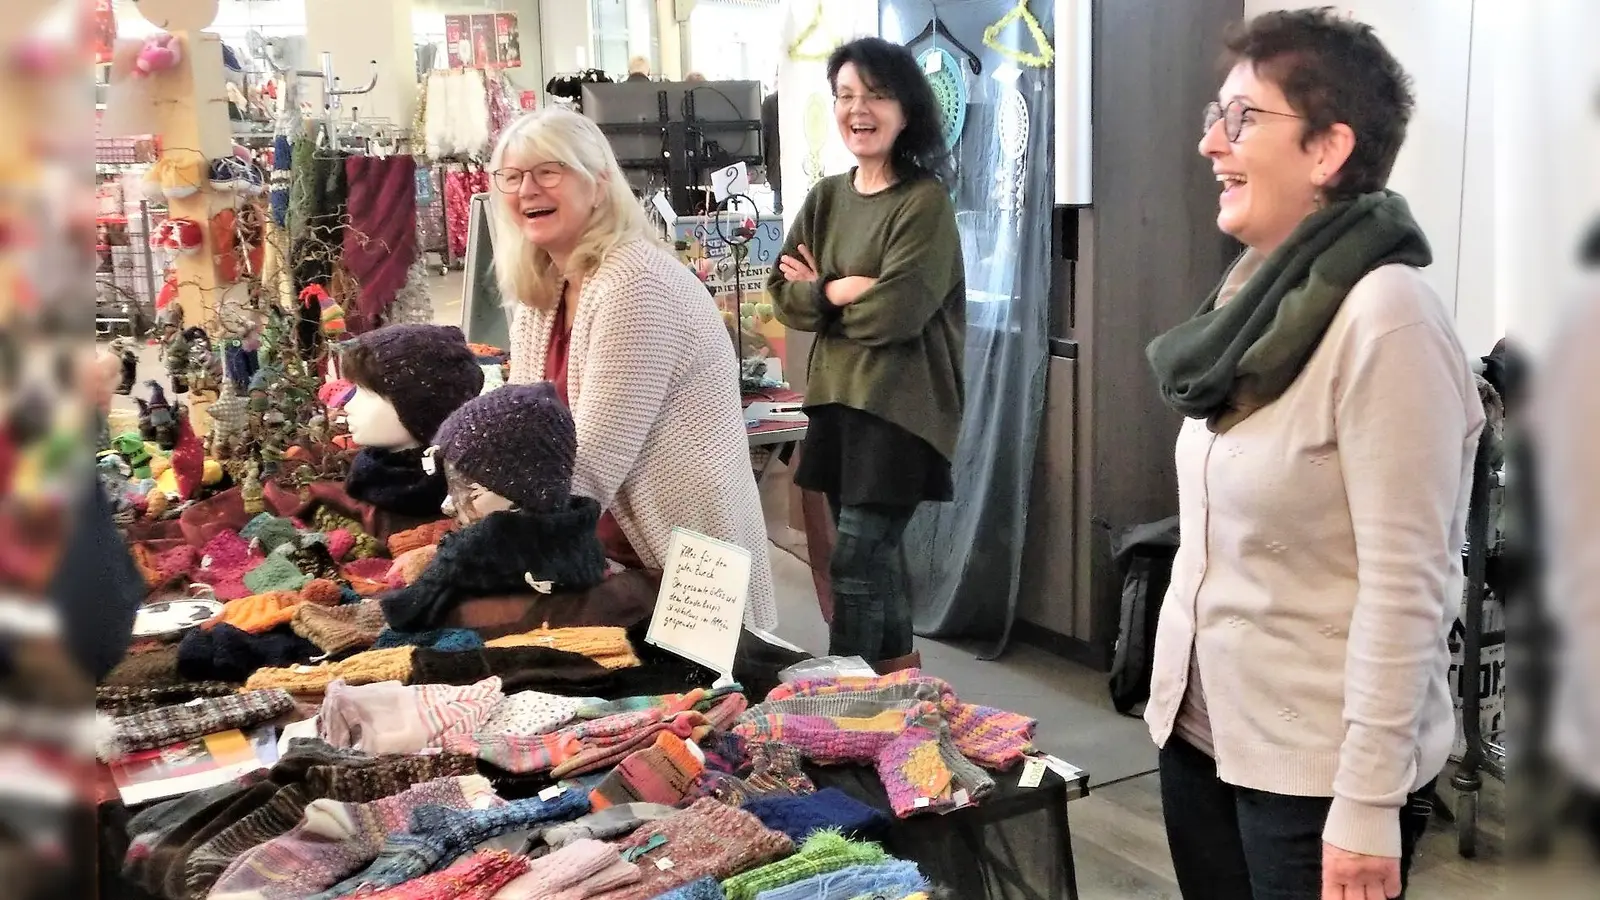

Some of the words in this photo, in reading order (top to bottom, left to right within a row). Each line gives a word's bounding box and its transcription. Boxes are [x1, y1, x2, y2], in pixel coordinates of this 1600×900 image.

[680, 543, 697, 560] Alles
[699, 550, 712, 570] für
[715, 556, 728, 568] den
[675, 562, 692, 574] guten
[694, 564, 715, 579] Zweck
[669, 592, 682, 602] dem
